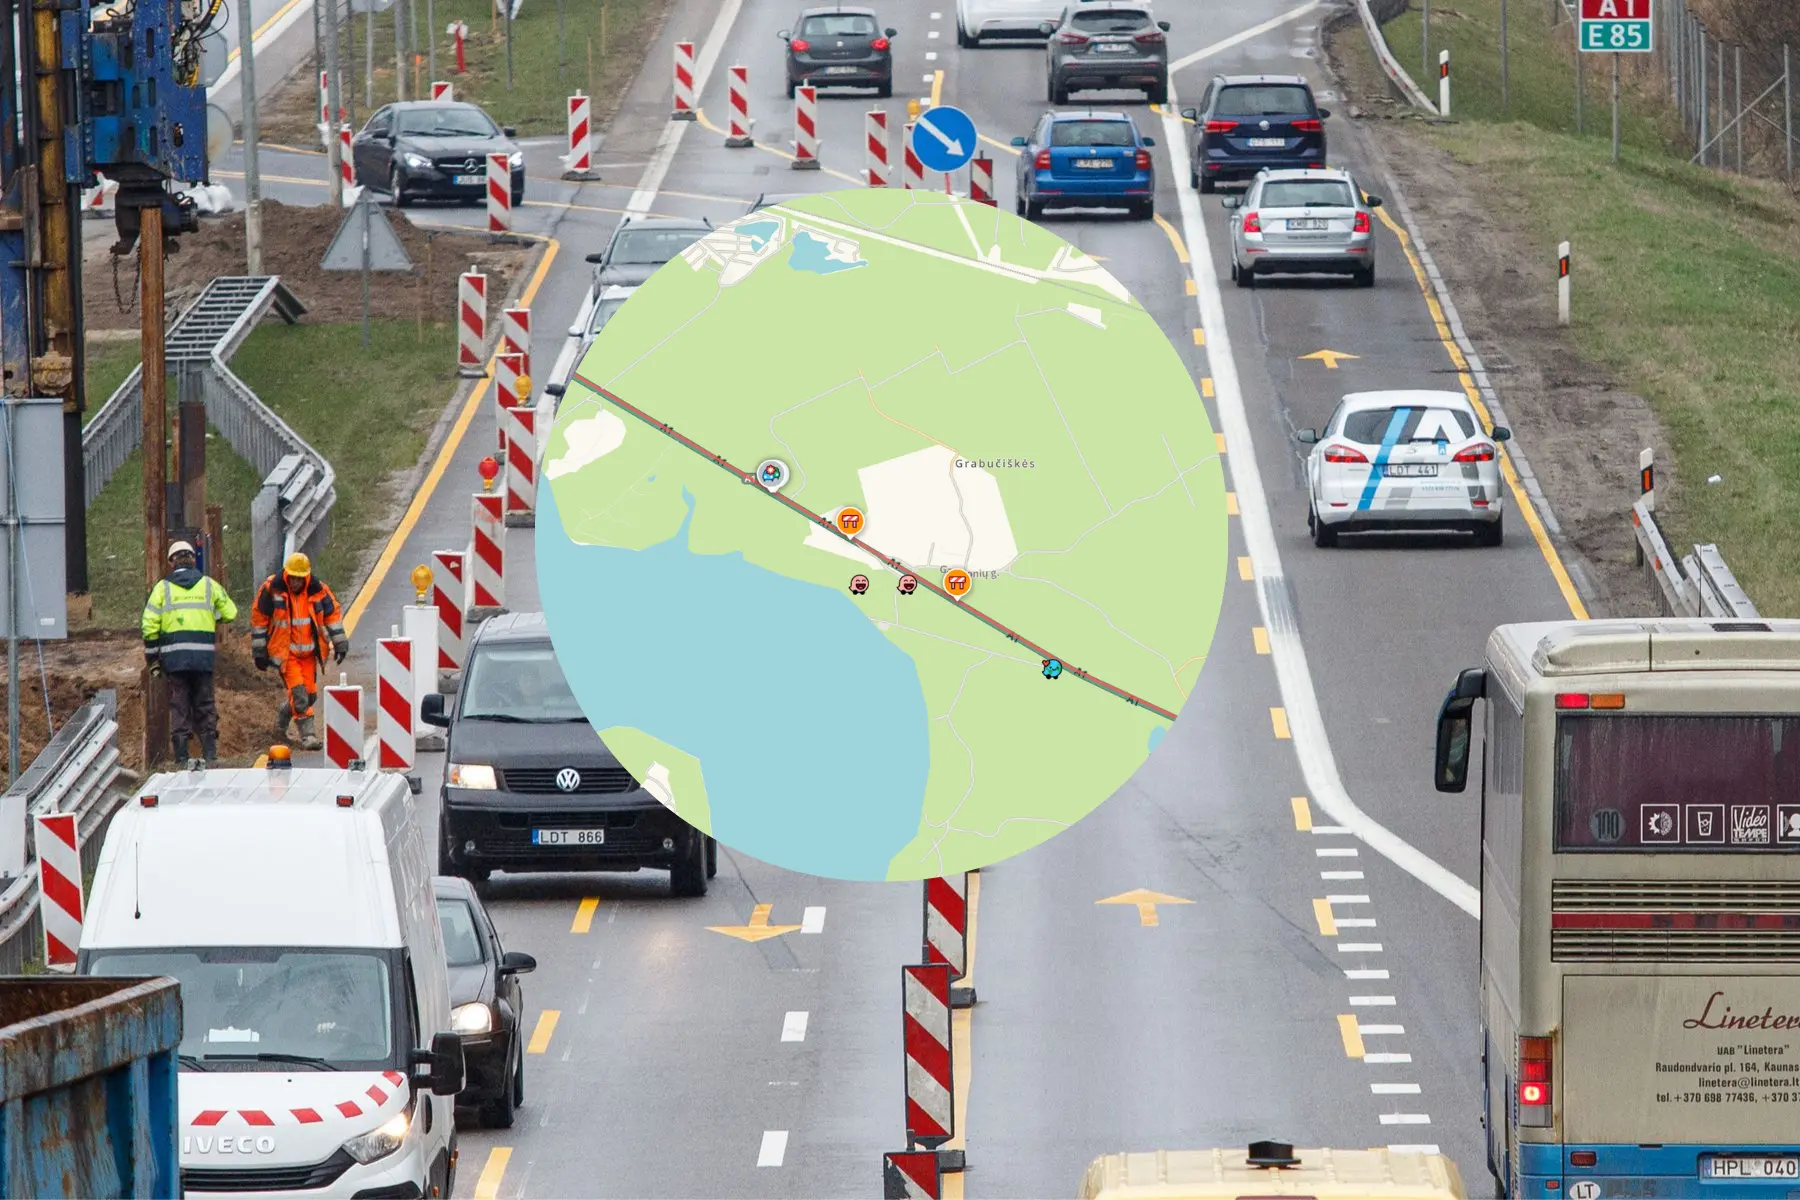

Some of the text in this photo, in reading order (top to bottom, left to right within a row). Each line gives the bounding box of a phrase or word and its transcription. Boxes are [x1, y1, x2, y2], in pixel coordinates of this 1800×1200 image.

[1598, 0, 1635, 17] A1
[1588, 24, 1643, 47] E 85
[1389, 464, 1410, 475] LDT
[1733, 805, 1767, 829] Vidéo
[1595, 811, 1619, 839] 100
[540, 831, 602, 843] LDT 866
[1733, 828, 1768, 839] TEMPE
[1683, 991, 1800, 1030] Lineter
[1717, 1044, 1790, 1056] UAB "Linetera"
[1655, 1062, 1800, 1075] Raudondvario pl. 164, Kaunas
[1698, 1076, 1800, 1090] linetera@linetera.lt
[1704, 1092, 1722, 1103] 698
[1725, 1092, 1758, 1104] 77436,
[183, 1136, 276, 1155] IVECO
[1713, 1159, 1796, 1176] HPL 040
[1576, 1184, 1594, 1199] LT
